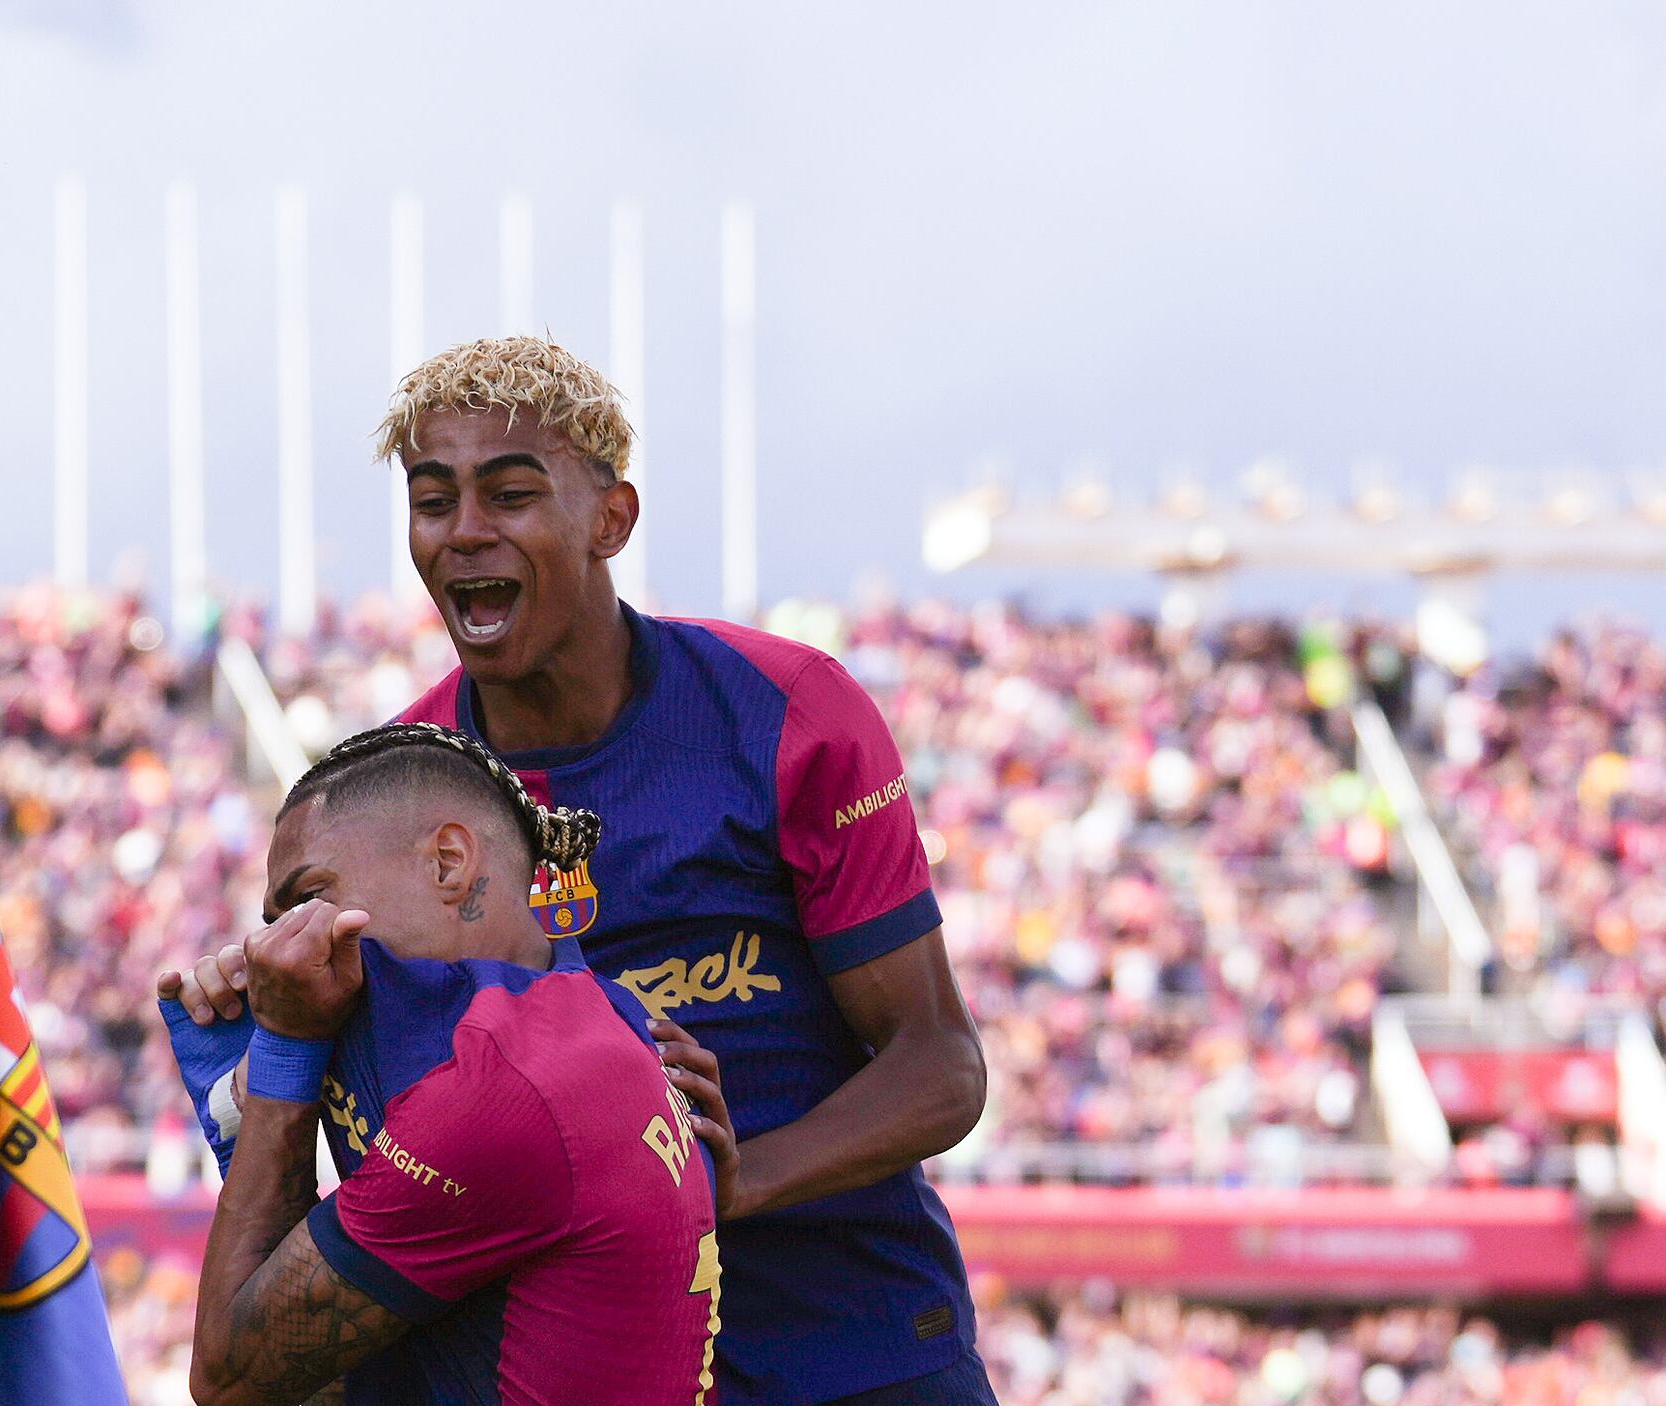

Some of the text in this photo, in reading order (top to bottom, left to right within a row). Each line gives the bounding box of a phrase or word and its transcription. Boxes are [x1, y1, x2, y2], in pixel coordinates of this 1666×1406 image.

[835, 773, 908, 829] AMBILIGHT
[545, 889, 575, 904] FCB
[443, 1178, 468, 1197] tv
